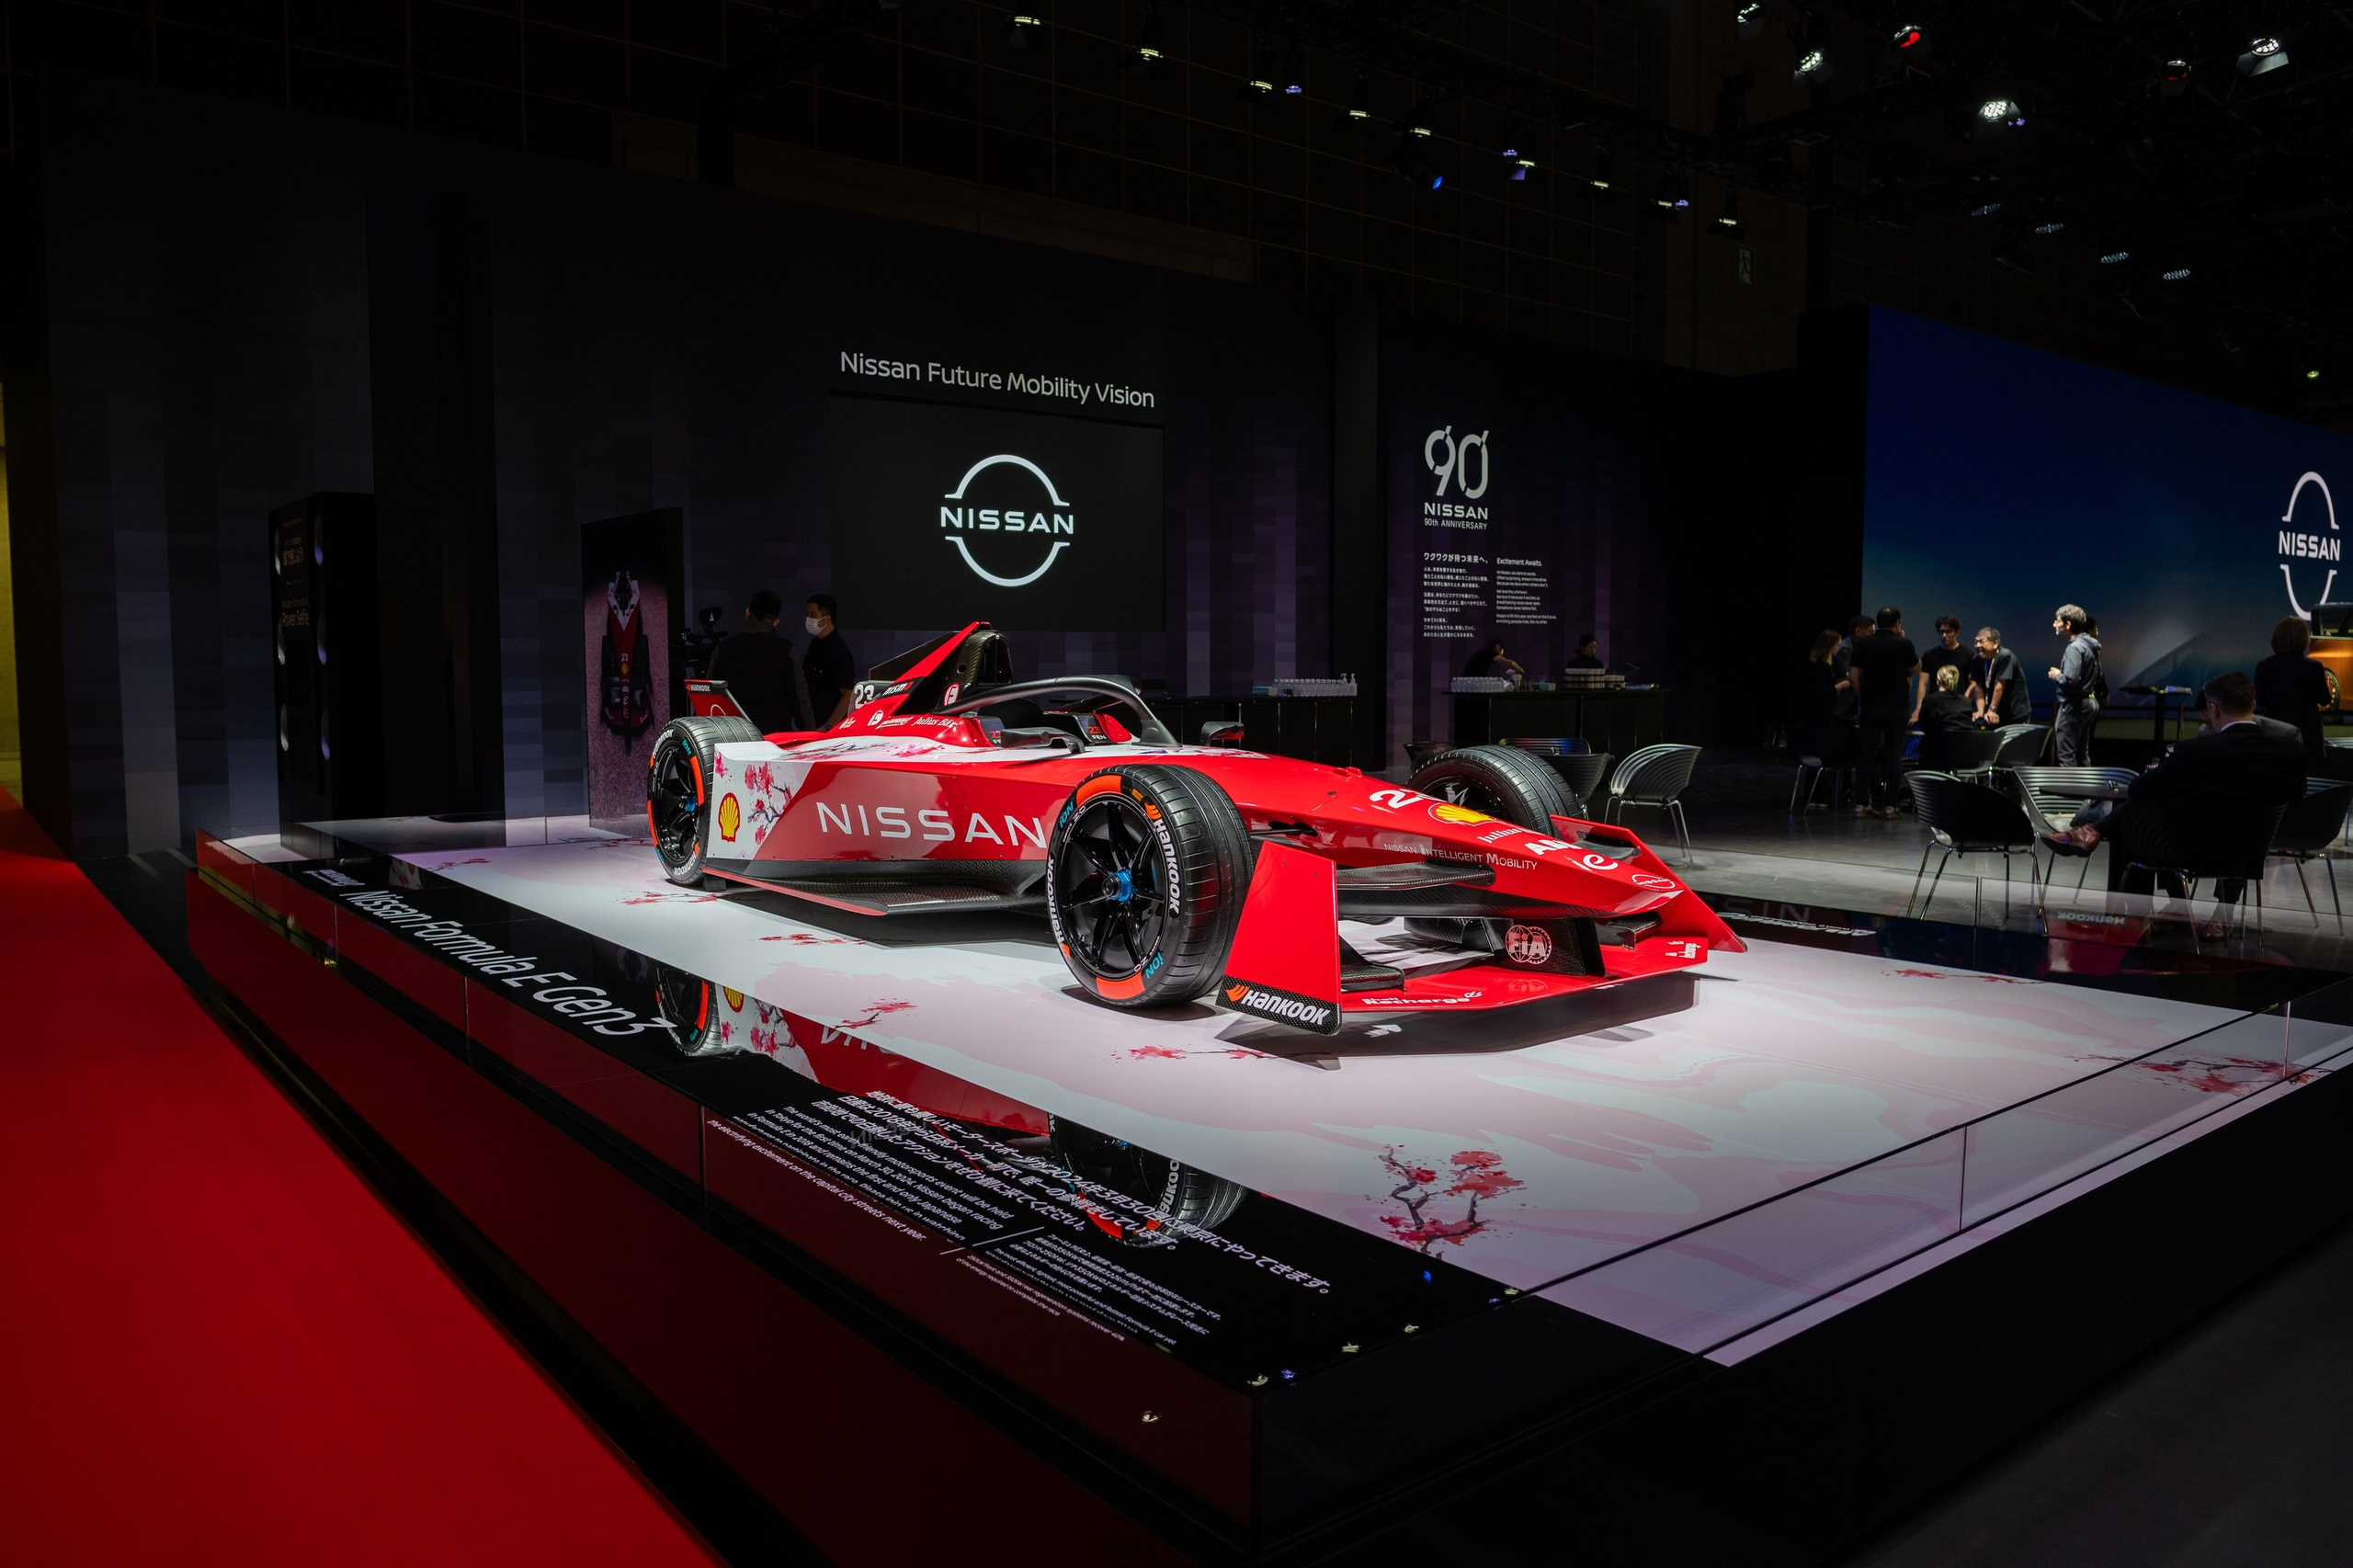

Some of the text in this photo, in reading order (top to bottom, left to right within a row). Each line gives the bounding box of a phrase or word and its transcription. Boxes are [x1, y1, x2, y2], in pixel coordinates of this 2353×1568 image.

[841, 351, 1154, 407] Nissan Future Mobility Vision
[1425, 426, 1489, 499] 90
[940, 506, 1074, 534] NISSAN
[1424, 517, 1488, 530] 90th ANNIVERSARY
[1425, 502, 1488, 520] NISSAN
[1424, 552, 1488, 564] ワクワクが待つ未来へ。
[2279, 530, 2341, 561] NISSAN
[854, 684, 875, 710] 23
[1087, 726, 1101, 734] 23
[816, 802, 1047, 848] NISSAN
[1383, 844, 1538, 870] NISSAN INTELLIGENT MOBILITY
[339, 890, 678, 1036] Nissan Formula E Gen3
[753, 1115, 787, 1131] Formula
[791, 1135, 815, 1145] 2018
[807, 1143, 830, 1153] and
[821, 1151, 859, 1168] remains
[850, 1166, 873, 1176] the
[864, 1173, 889, 1184] first
[880, 1181, 906, 1192] and
[894, 1190, 925, 1203] only
[913, 1199, 966, 1224] Japanese
[768, 1112, 798, 1124] Tokyo
[799, 1127, 820, 1135] the
[811, 1132, 834, 1142] first
[824, 1140, 850, 1151] time
[841, 1148, 861, 1156] on
[852, 1153, 885, 1168] March
[874, 1165, 897, 1175] 30,
[910, 1183, 948, 1199] Nissan
[937, 1198, 976, 1215] began
[965, 1211, 1006, 1230] racing
[780, 1106, 1015, 1219] The world's most earth-friendly motorsports event will be held
[717, 1125, 758, 1146] electrifying
[751, 1143, 795, 1165] excitement
[788, 1164, 806, 1172] on
[798, 1170, 819, 1179] the
[810, 1177, 845, 1194] capital
[835, 1191, 859, 1202] city
[850, 1199, 888, 1218] streets
[879, 1215, 908, 1229] next
[897, 1226, 930, 1241] year.
